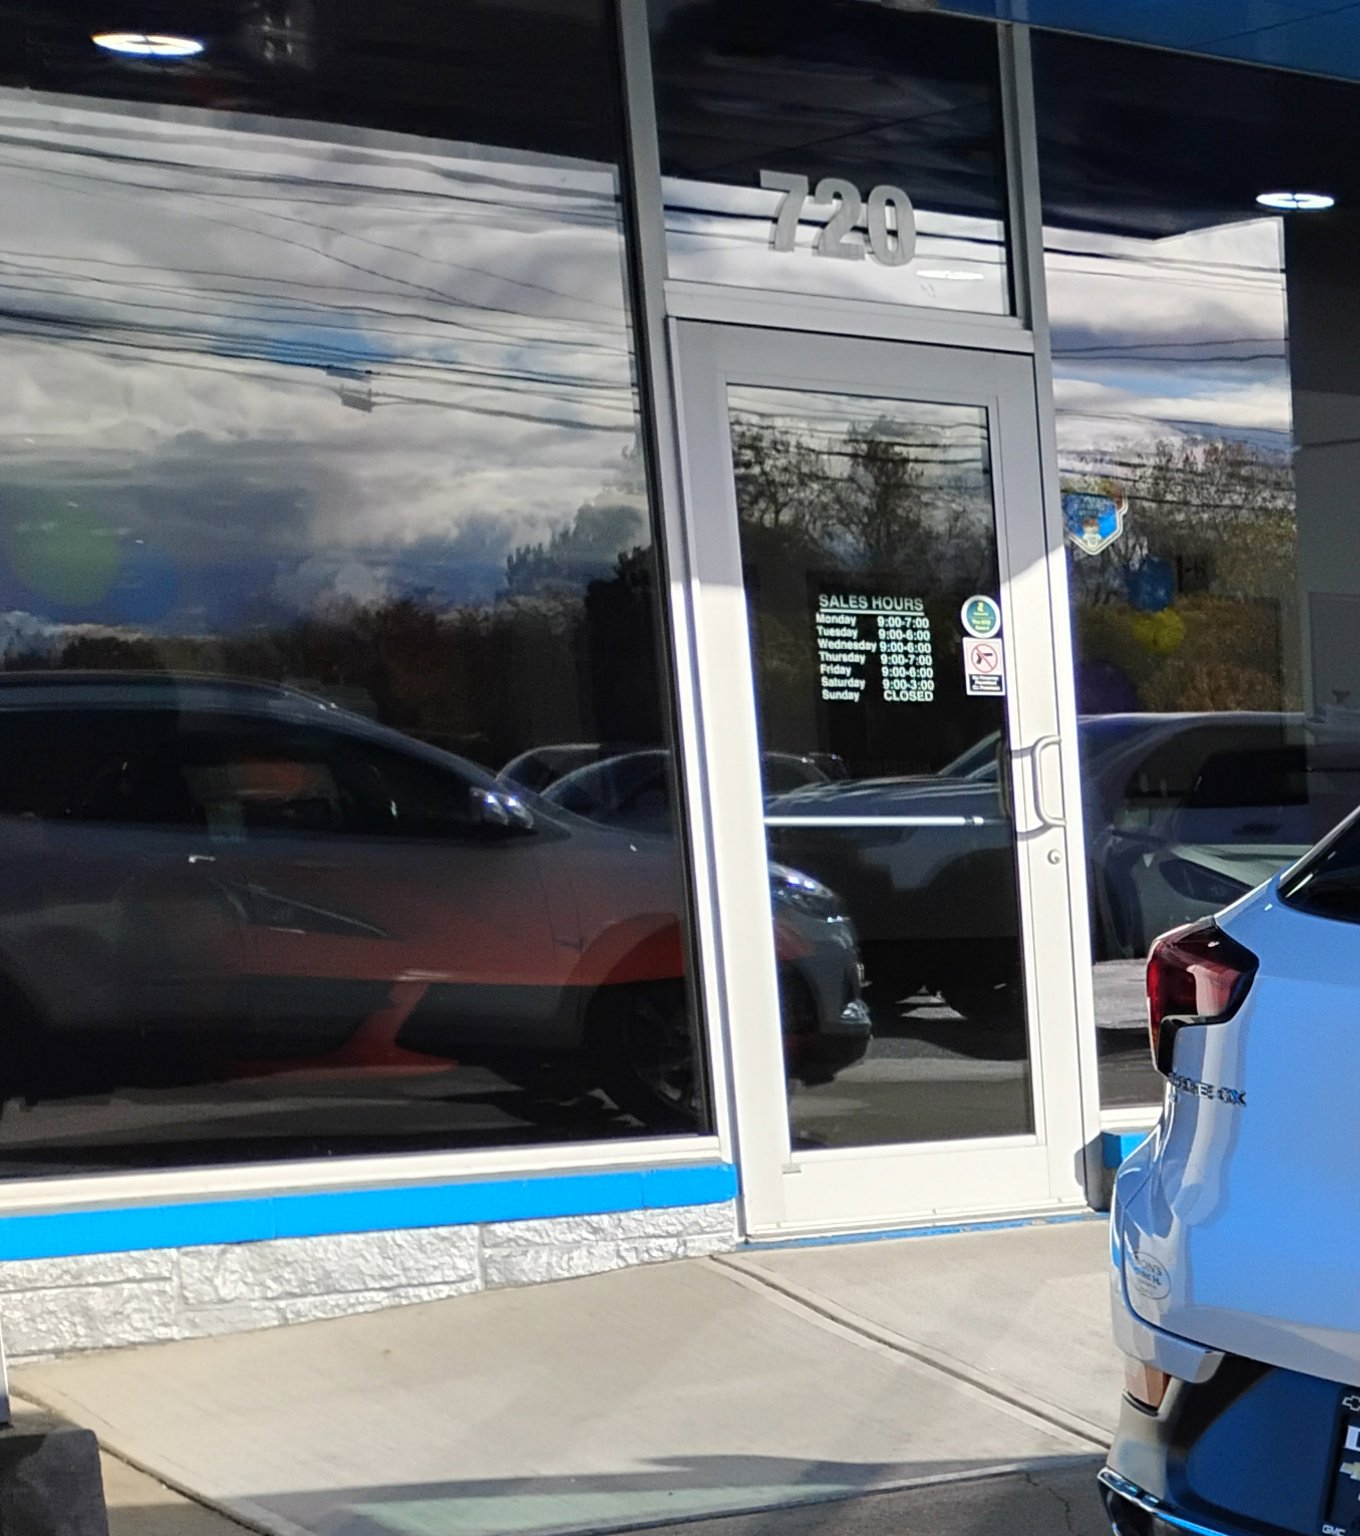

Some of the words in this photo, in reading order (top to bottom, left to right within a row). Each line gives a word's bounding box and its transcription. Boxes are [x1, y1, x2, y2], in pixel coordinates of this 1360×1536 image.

[760, 169, 916, 267] 720
[818, 594, 868, 609] SALES
[872, 597, 924, 612] HOURS
[816, 612, 857, 626] Monday
[877, 617, 930, 628] 9:00-7:00
[816, 626, 858, 639] Tuesday
[817, 638, 877, 652] Wednesday
[818, 651, 866, 664] Thursday
[880, 654, 933, 666] 9:00-7:00
[820, 664, 852, 677] Friday
[821, 676, 866, 690] Saturday
[822, 689, 860, 702] Sunday
[883, 691, 934, 702] CLOSED
